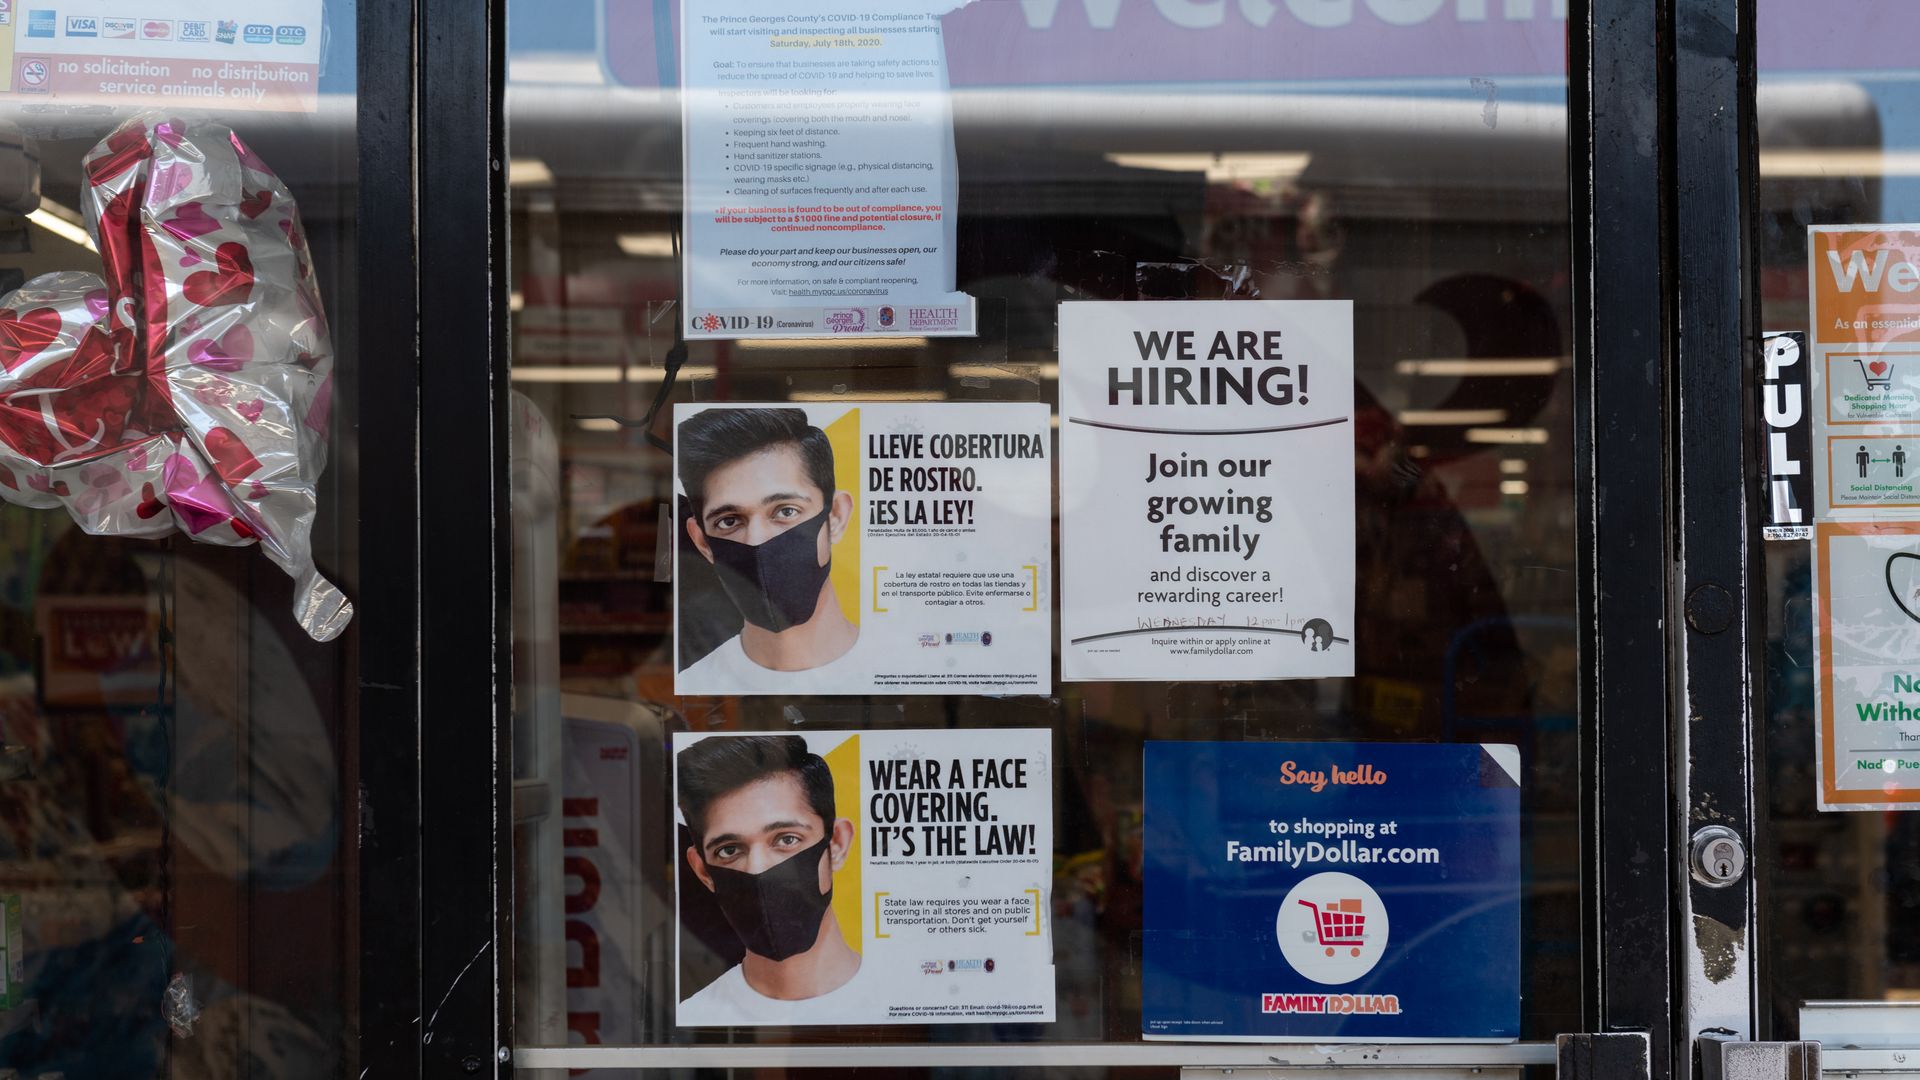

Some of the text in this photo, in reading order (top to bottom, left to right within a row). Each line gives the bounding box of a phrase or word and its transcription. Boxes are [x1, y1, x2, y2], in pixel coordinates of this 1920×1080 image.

[70, 19, 96, 29] VISA
[184, 21, 205, 31] DEBIT
[749, 15, 785, 24] Georges
[787, 15, 826, 23] County's
[828, 14, 870, 22] COVID-19
[872, 13, 924, 22] Compliance
[248, 25, 270, 34] OTC
[280, 26, 304, 35] OTC
[770, 40, 811, 48] Saturday,
[813, 39, 831, 48] July
[835, 39, 855, 47] 18th,
[58, 58, 309, 82] no solicitation no distribution
[99, 80, 266, 103] service animals only
[744, 215, 775, 224] subject
[860, 214, 898, 222] potential
[771, 224, 885, 232] continued noncompliance.
[1826, 250, 1920, 293] We
[910, 309, 957, 319] HEALTH
[776, 320, 814, 329] (Coronavirus)
[832, 323, 865, 333] Proud
[1835, 318, 1849, 329] As
[1853, 320, 1868, 329] an
[1134, 330, 1283, 361] WE ARE
[1108, 364, 1309, 406] HIRING!
[1763, 336, 1802, 523] PULL
[869, 433, 1044, 459] LLEVE COBERTURA
[1145, 452, 1272, 483] Join our
[869, 466, 983, 492] DE ROSTRO.
[869, 500, 974, 524] ¡ES LA LEY!
[1147, 488, 1272, 523] growing
[1160, 524, 1260, 561] family
[943, 572, 971, 580] requiere
[1150, 566, 1270, 582] and discover a
[925, 599, 957, 607] contagiar
[1138, 587, 1284, 607] rewarding career!
[1170, 647, 1253, 655] www.familydollar.com
[1215, 638, 1236, 646] apply
[869, 759, 1027, 790] WEAR A FACE
[1280, 760, 1388, 792] Say hello
[870, 792, 998, 823] COVERING.
[1269, 817, 1398, 839] to shopping at
[871, 824, 1036, 857] IT'S THE LAW!
[1226, 840, 1440, 869] FamilyDollar.com
[883, 908, 920, 916] covering
[1004, 906, 1030, 915] public
[884, 899, 906, 907] State
[926, 899, 960, 907] requires
[887, 917, 950, 925] transportation.
[994, 916, 1028, 924] yourself
[1263, 993, 1398, 1015] FAMILY DOLLAR
